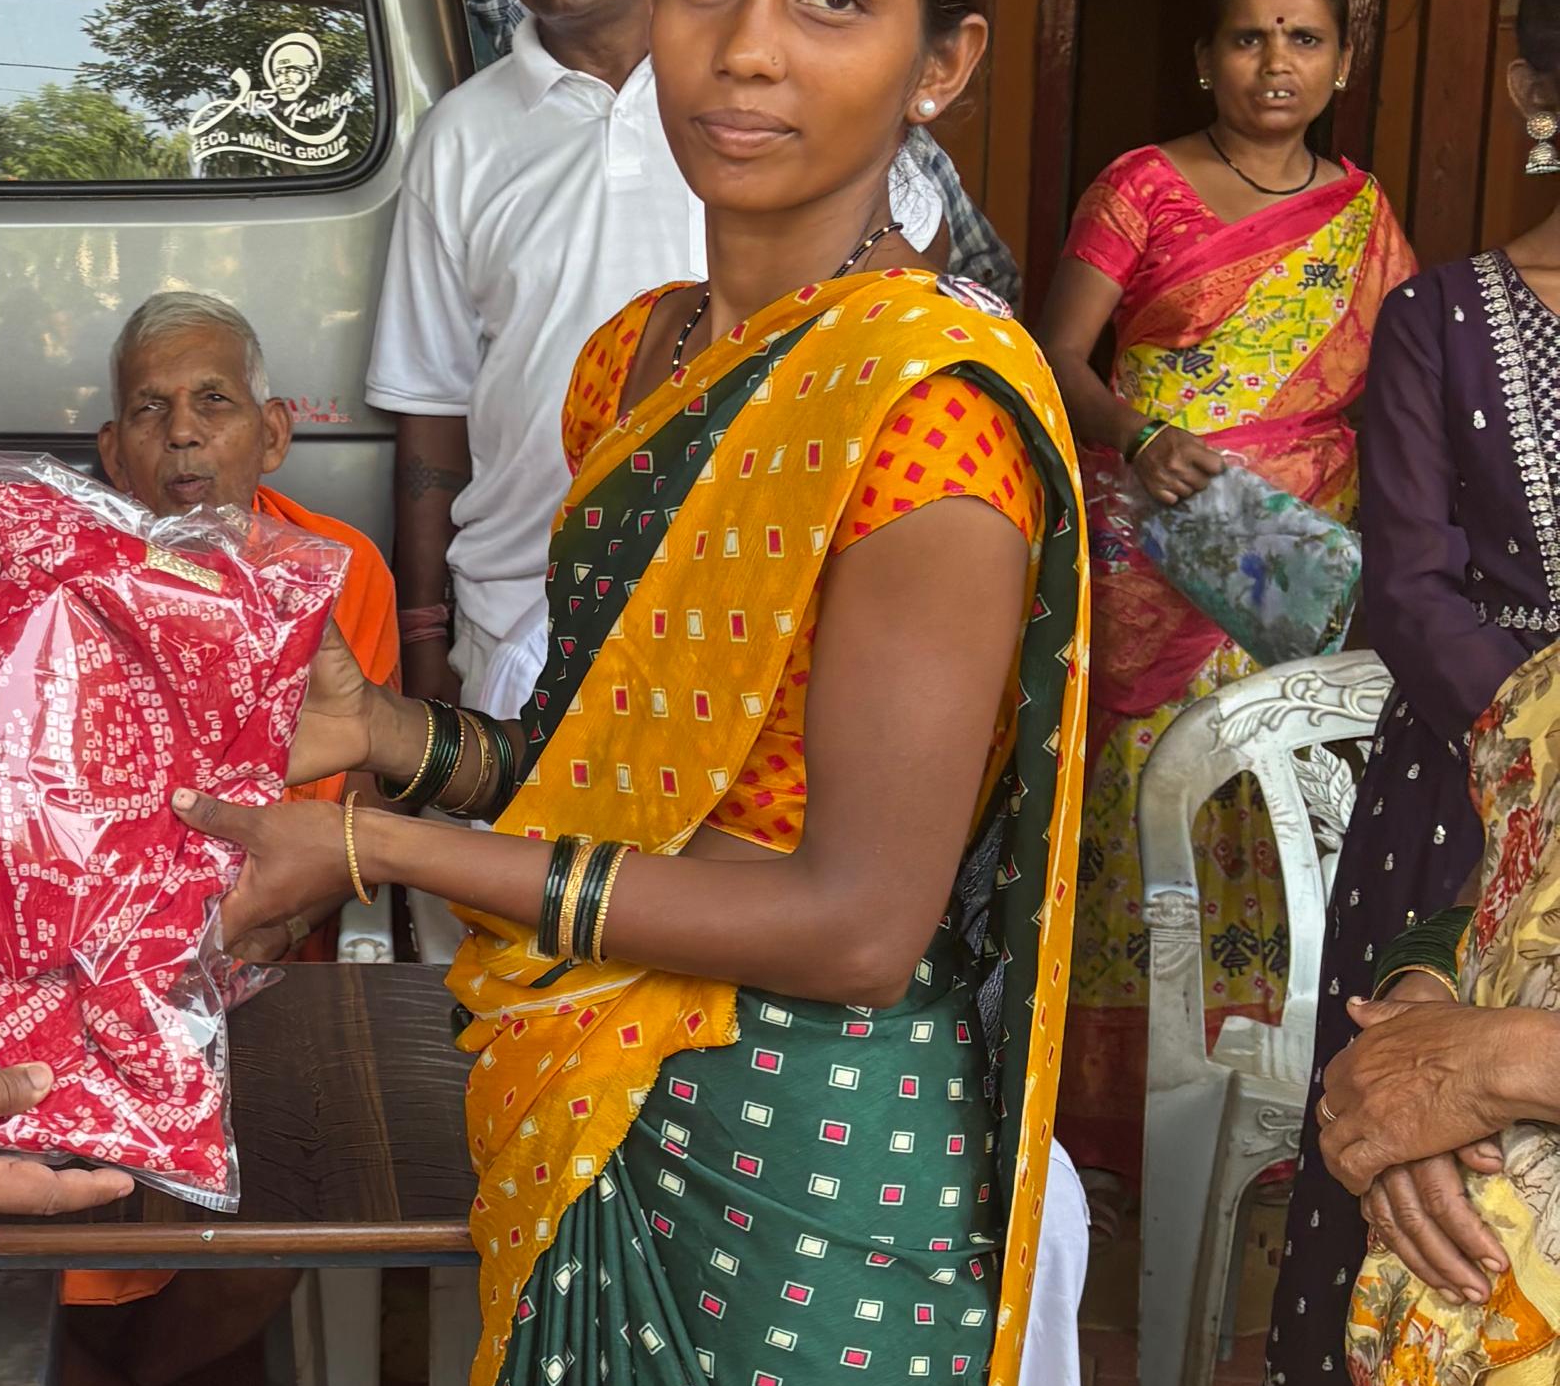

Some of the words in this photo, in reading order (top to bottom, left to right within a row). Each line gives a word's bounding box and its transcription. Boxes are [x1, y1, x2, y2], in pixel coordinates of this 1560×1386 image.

[283, 90, 355, 129] Krupa
[239, 132, 291, 157] MAGIC
[295, 135, 348, 159] GROUP
